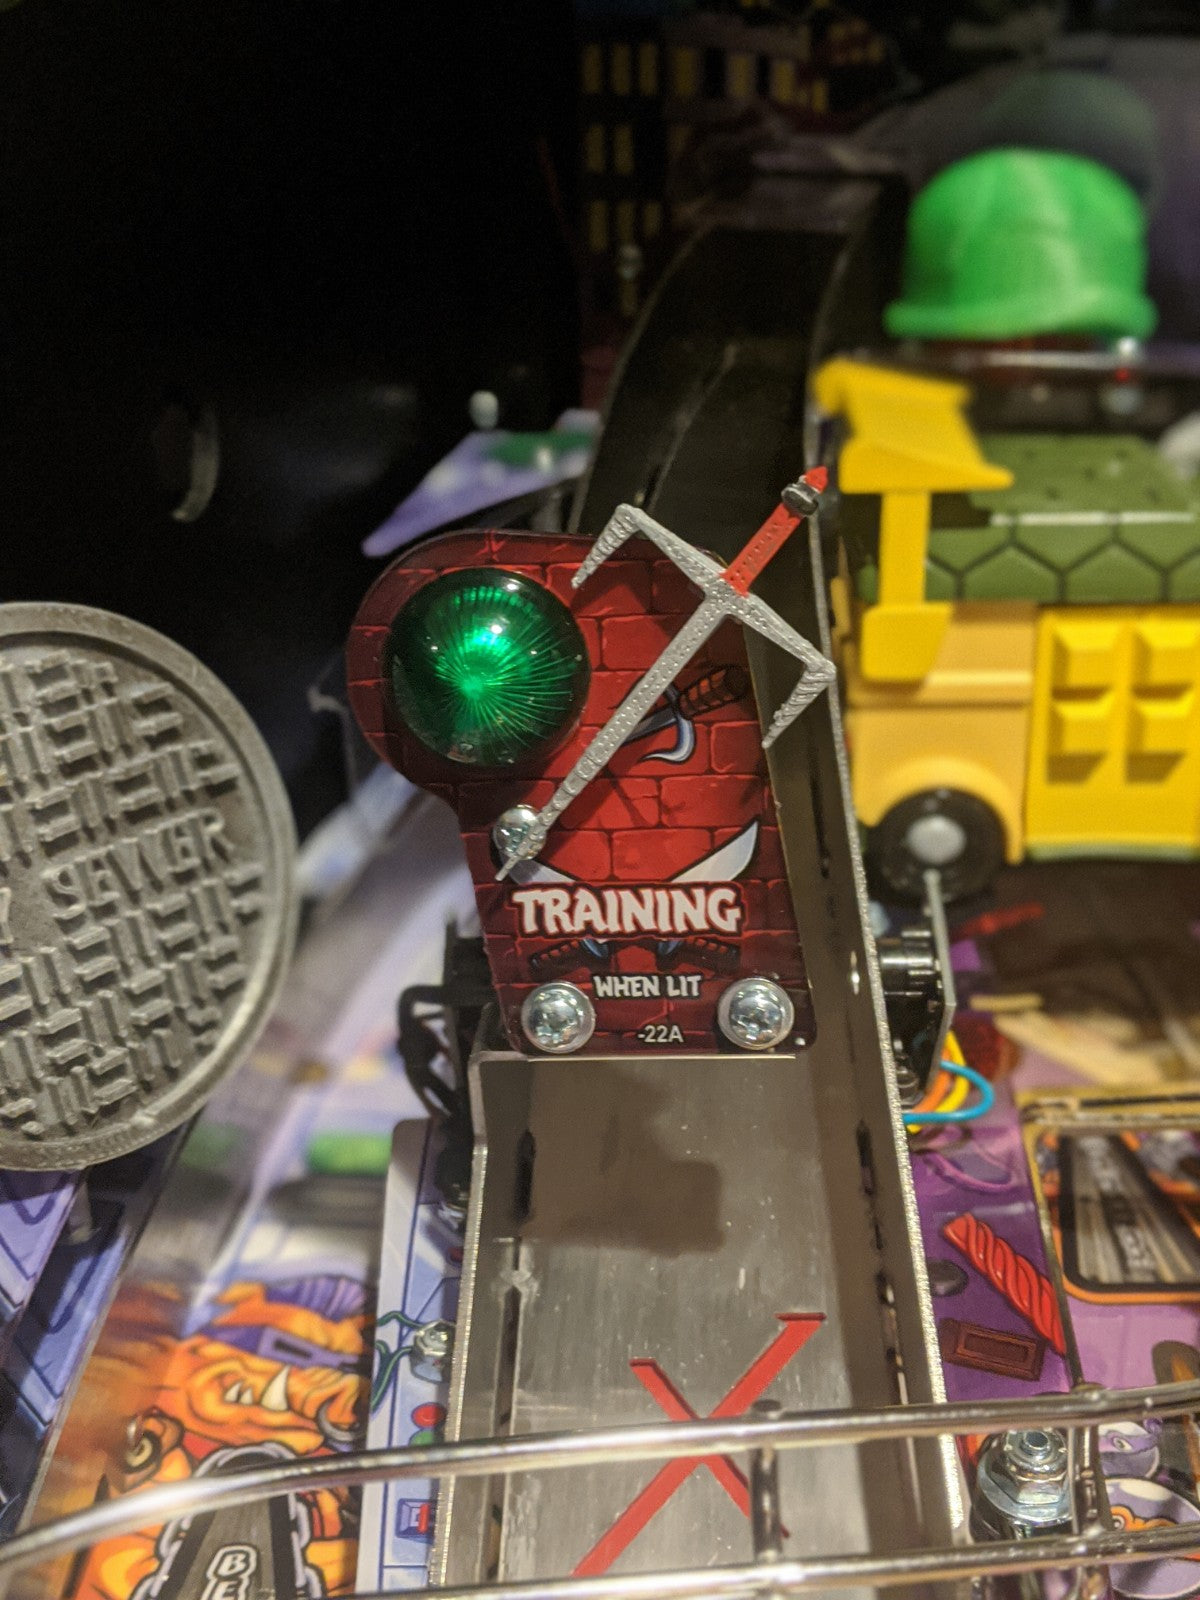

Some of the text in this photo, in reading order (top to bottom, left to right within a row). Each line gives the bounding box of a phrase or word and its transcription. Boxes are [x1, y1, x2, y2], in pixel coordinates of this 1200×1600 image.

[41, 807, 235, 919] SEWER
[511, 887, 742, 935] TRAINING
[593, 975, 702, 998] WHEN LIT
[637, 1025, 684, 1043] -22A
